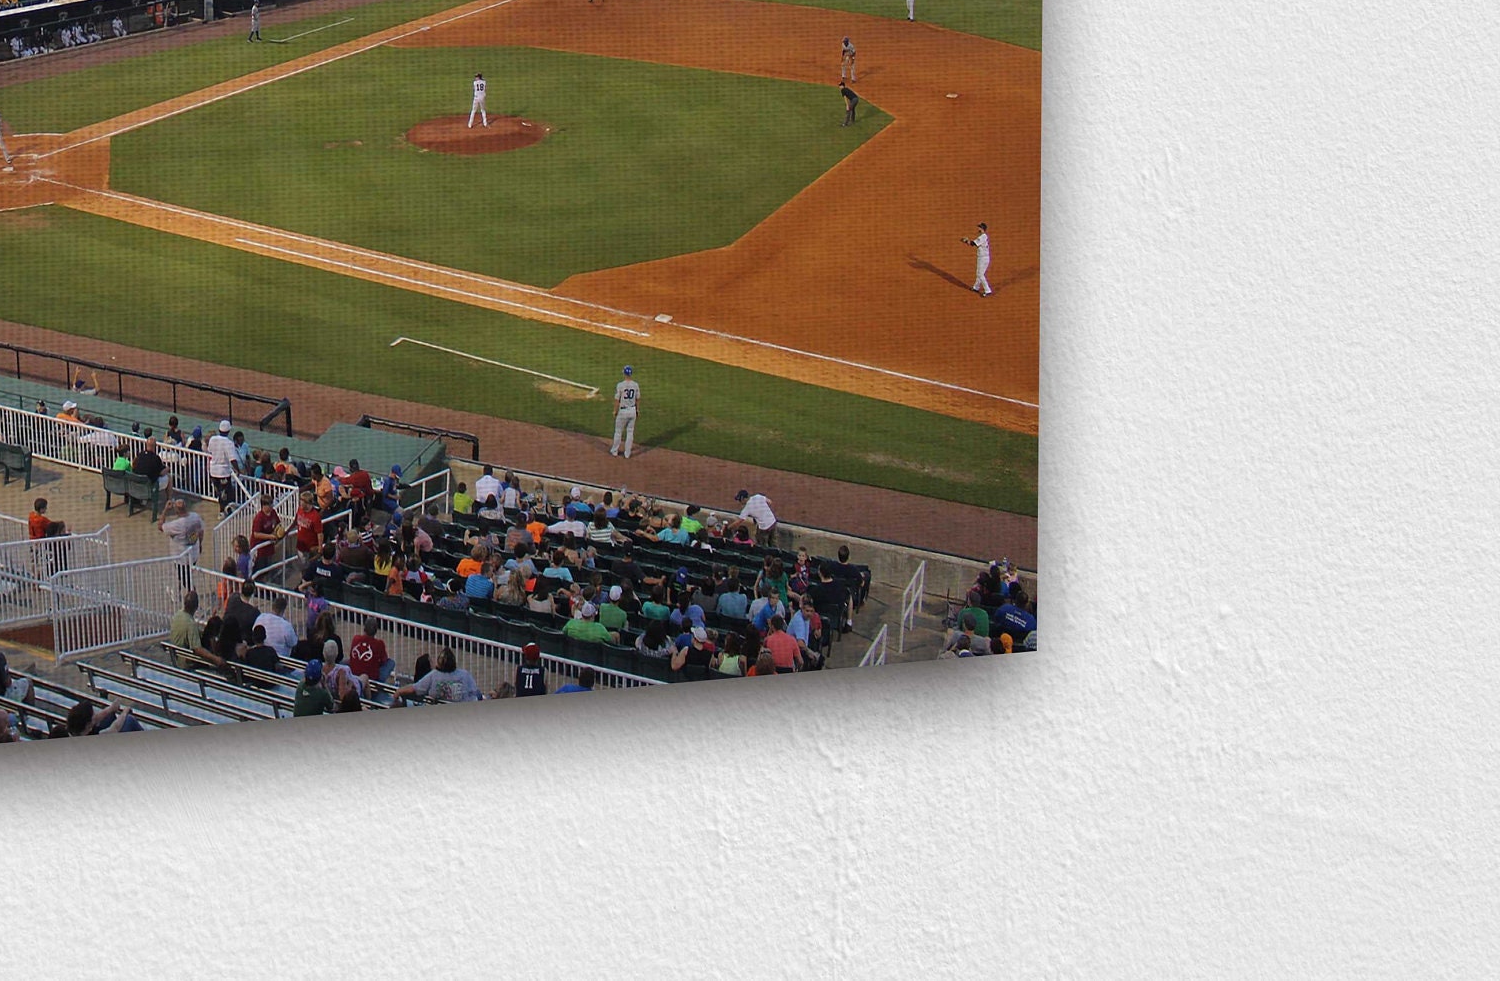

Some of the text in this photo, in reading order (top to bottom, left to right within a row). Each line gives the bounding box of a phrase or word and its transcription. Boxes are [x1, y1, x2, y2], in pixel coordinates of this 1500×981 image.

[476, 83, 485, 92] 18
[623, 388, 635, 400] 30
[524, 674, 533, 689] 11
